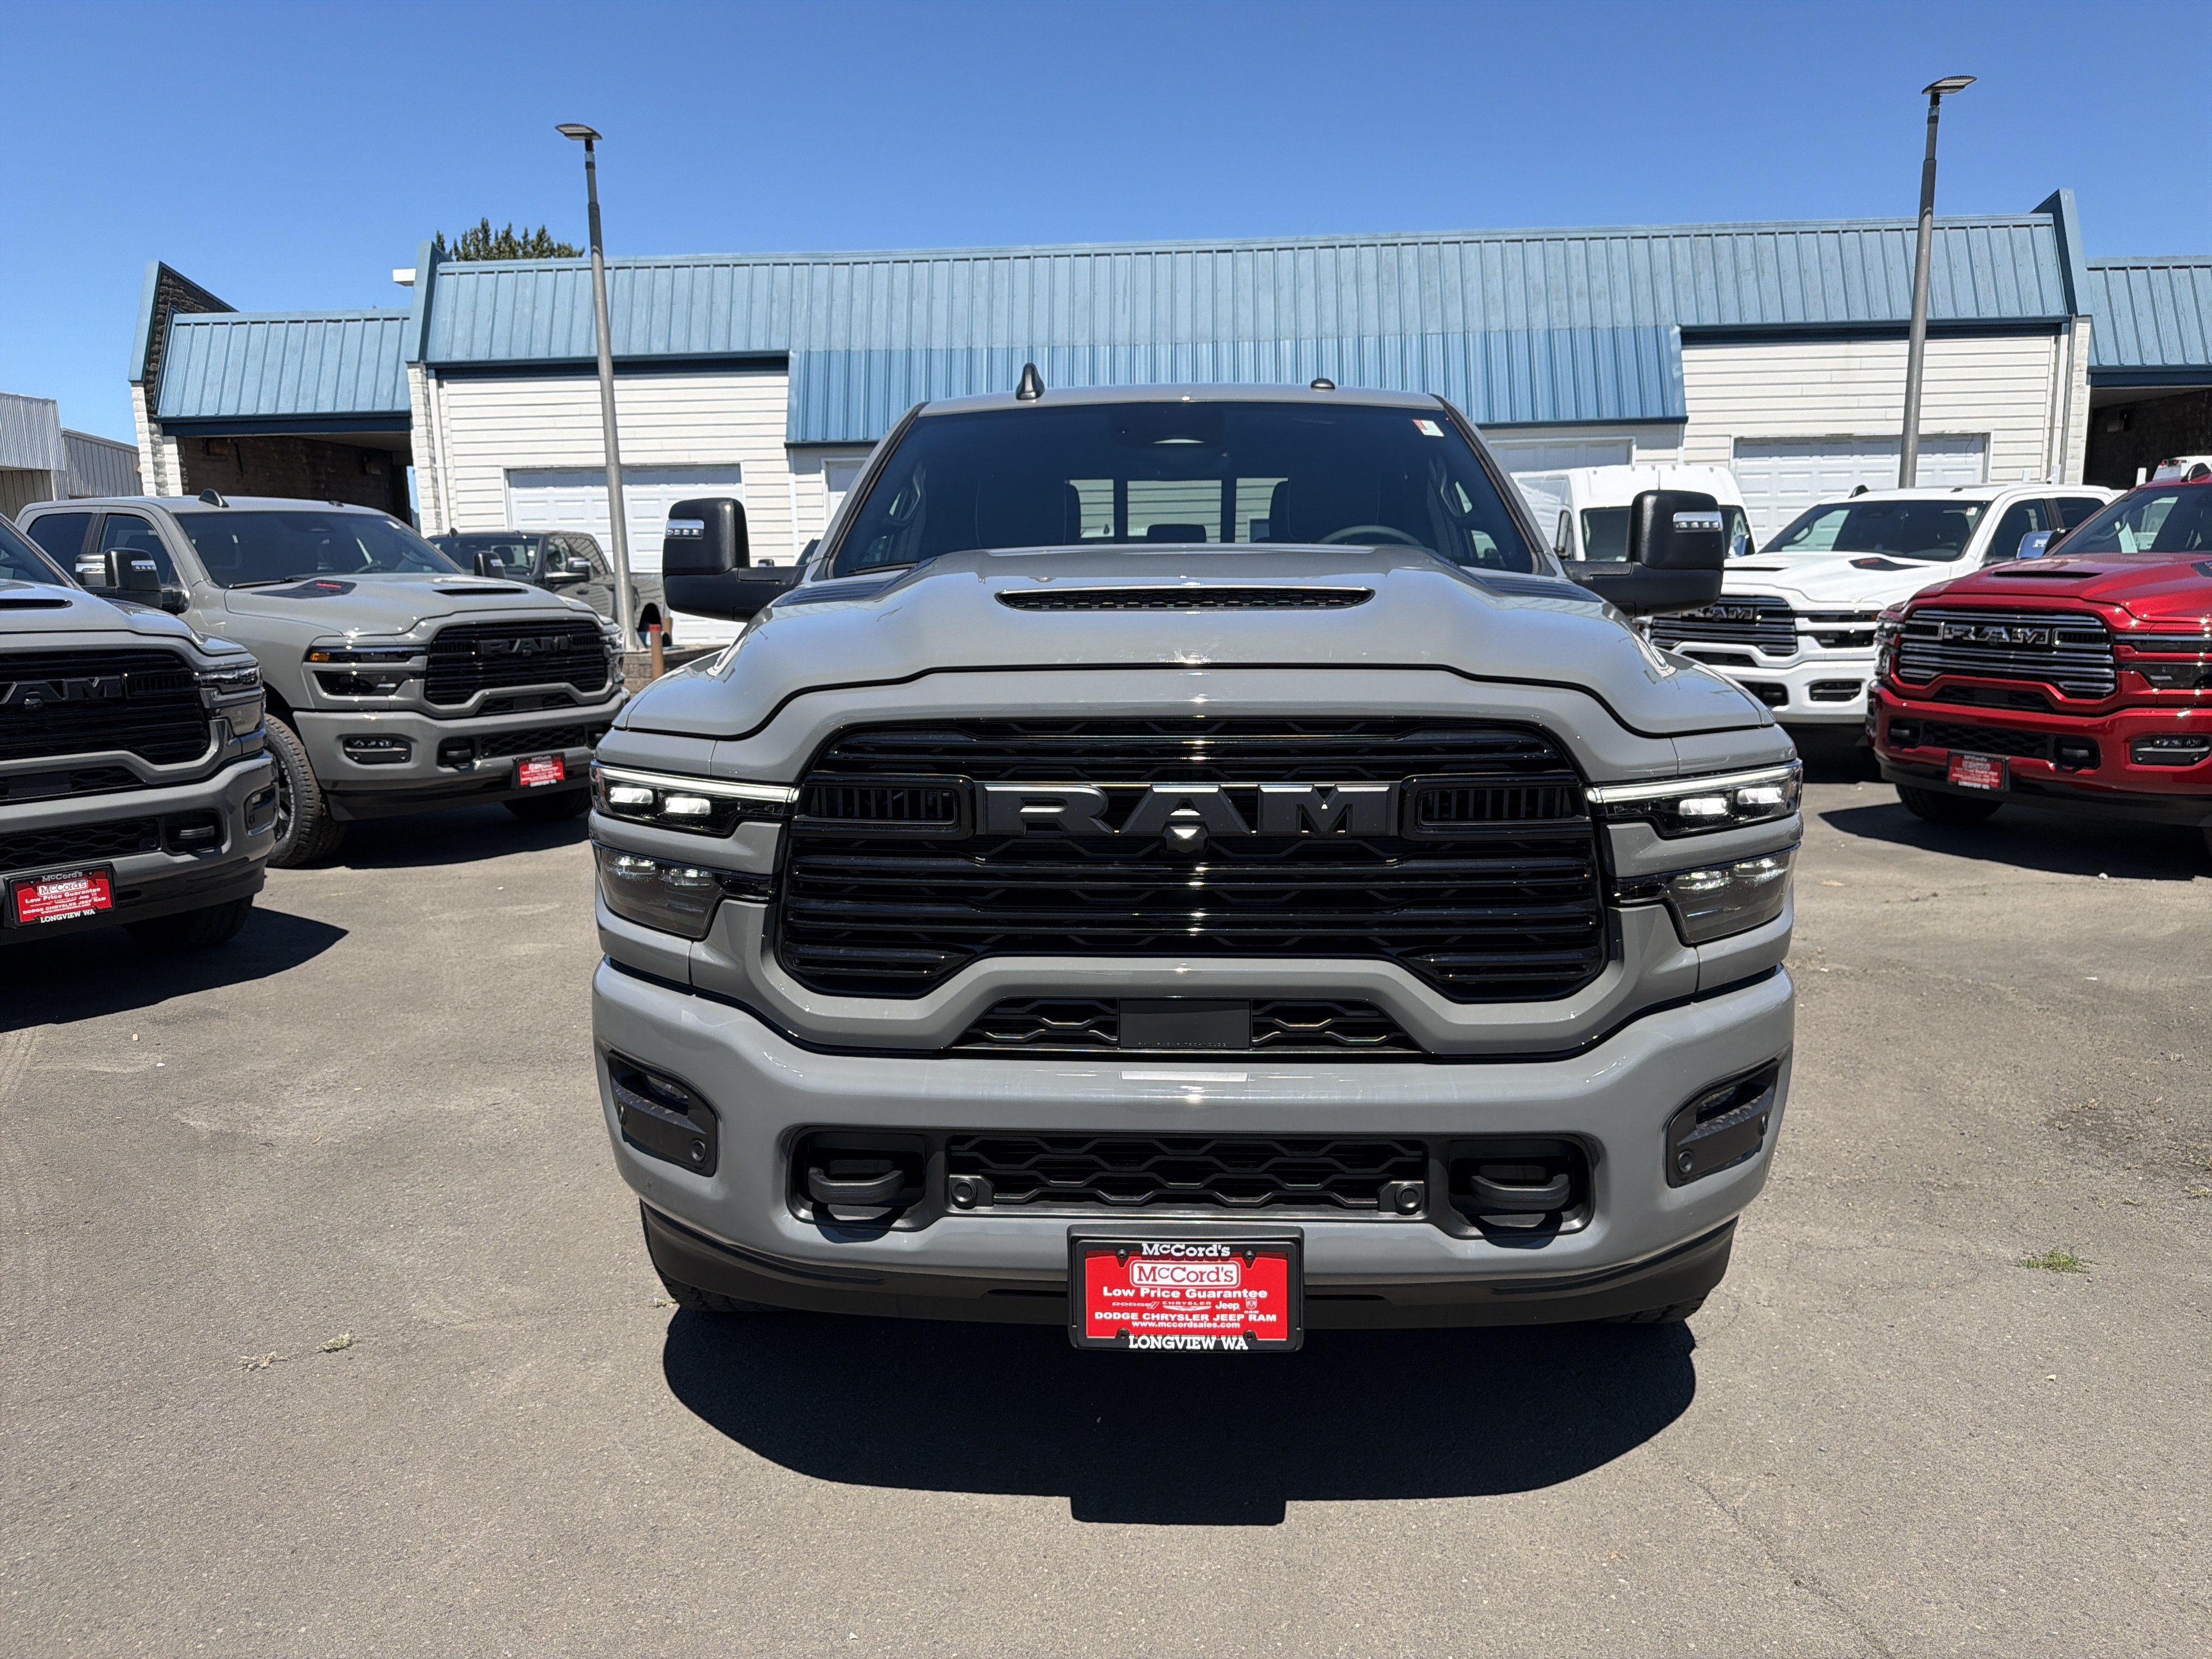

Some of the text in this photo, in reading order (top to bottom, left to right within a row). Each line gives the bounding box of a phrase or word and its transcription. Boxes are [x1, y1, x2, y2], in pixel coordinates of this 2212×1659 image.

[1944, 624, 2050, 645] RAM
[480, 636, 568, 654] RAM
[0, 676, 122, 704] AM
[984, 783, 1391, 835] RAM
[42, 871, 83, 882] McCord's
[40, 879, 86, 894] McCord's
[64, 887, 101, 897] Guarantee
[46, 902, 77, 911] CHRYSLER
[40, 912, 81, 923] LONGVIEW
[1142, 1243, 1231, 1257] McCord's
[1137, 1266, 1234, 1283] McCord's
[1103, 1286, 1268, 1299] Low Price Guarantee
[1215, 1301, 1240, 1311] Jeep
[1094, 1312, 1277, 1323] DODGE CHRYSLER JEEP RAM
[1132, 1321, 1240, 1329] www.mccordsales.com
[1128, 1335, 1249, 1351] LONGVIEW WA
